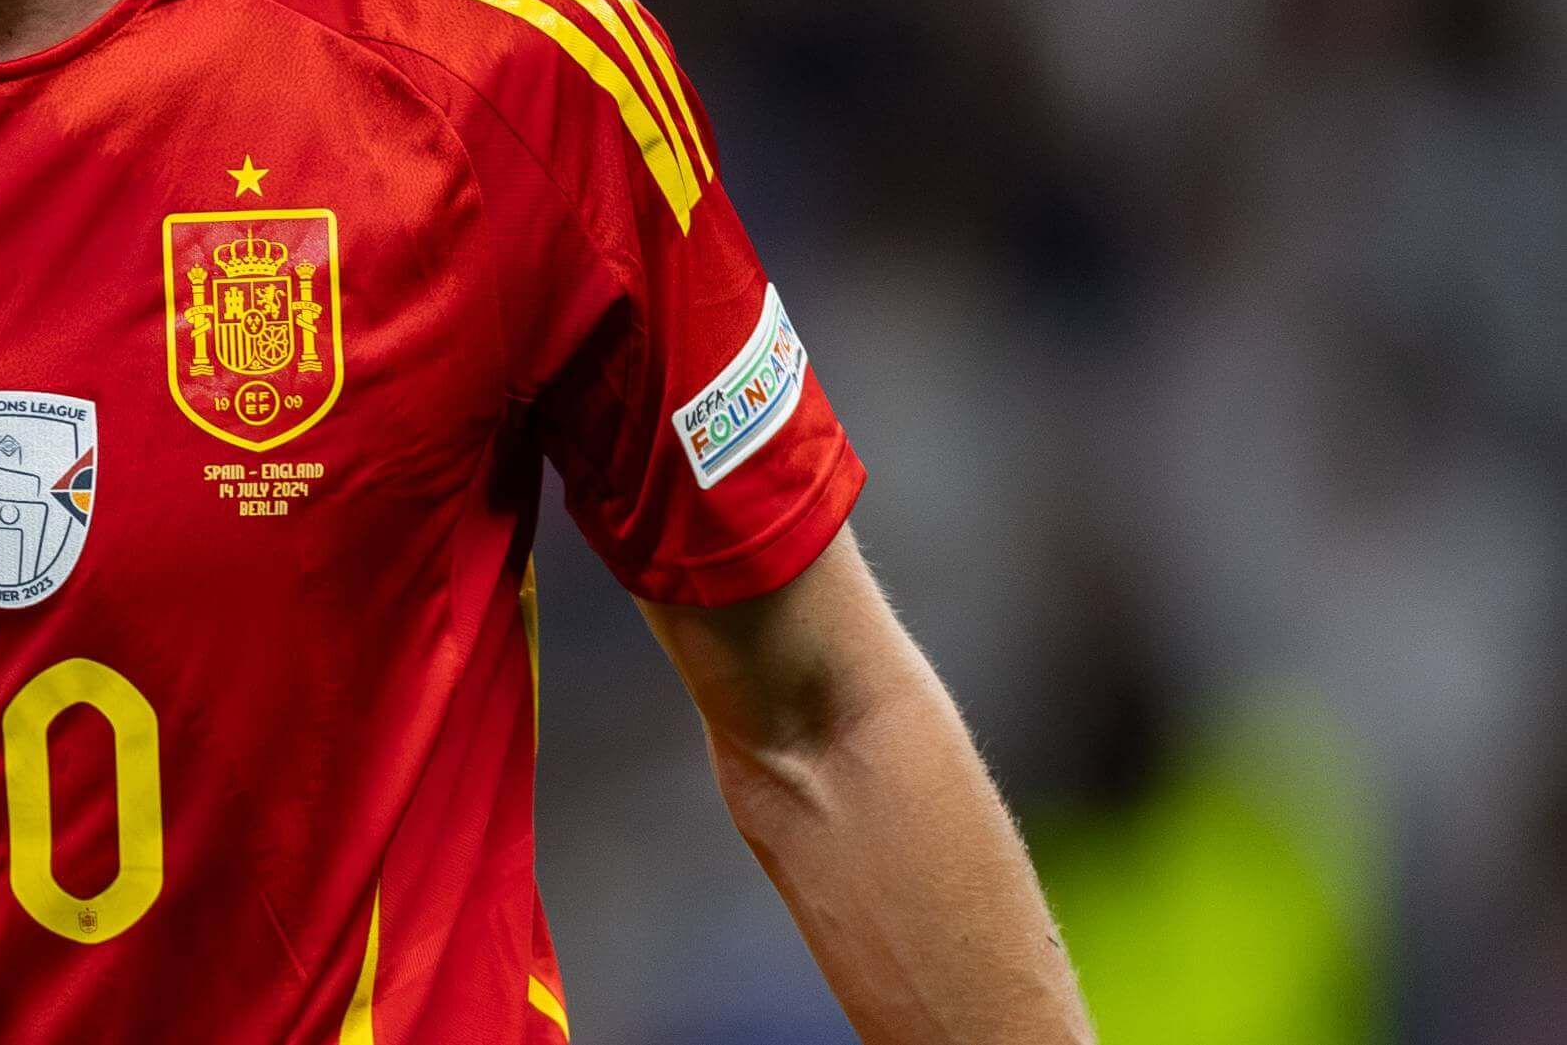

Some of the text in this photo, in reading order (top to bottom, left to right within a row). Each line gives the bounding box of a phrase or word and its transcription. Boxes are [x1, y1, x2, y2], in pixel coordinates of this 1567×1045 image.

[31, 401, 86, 420] LEAGUE
[214, 397, 230, 411] 19
[284, 394, 303, 409] 09
[685, 389, 725, 432] UEFA
[203, 464, 245, 481] SPAIN
[261, 463, 325, 480] ENGLAND
[219, 481, 309, 499] 14 JULY 2024
[239, 500, 289, 517] BERLIN
[22, 576, 53, 599] 2023
